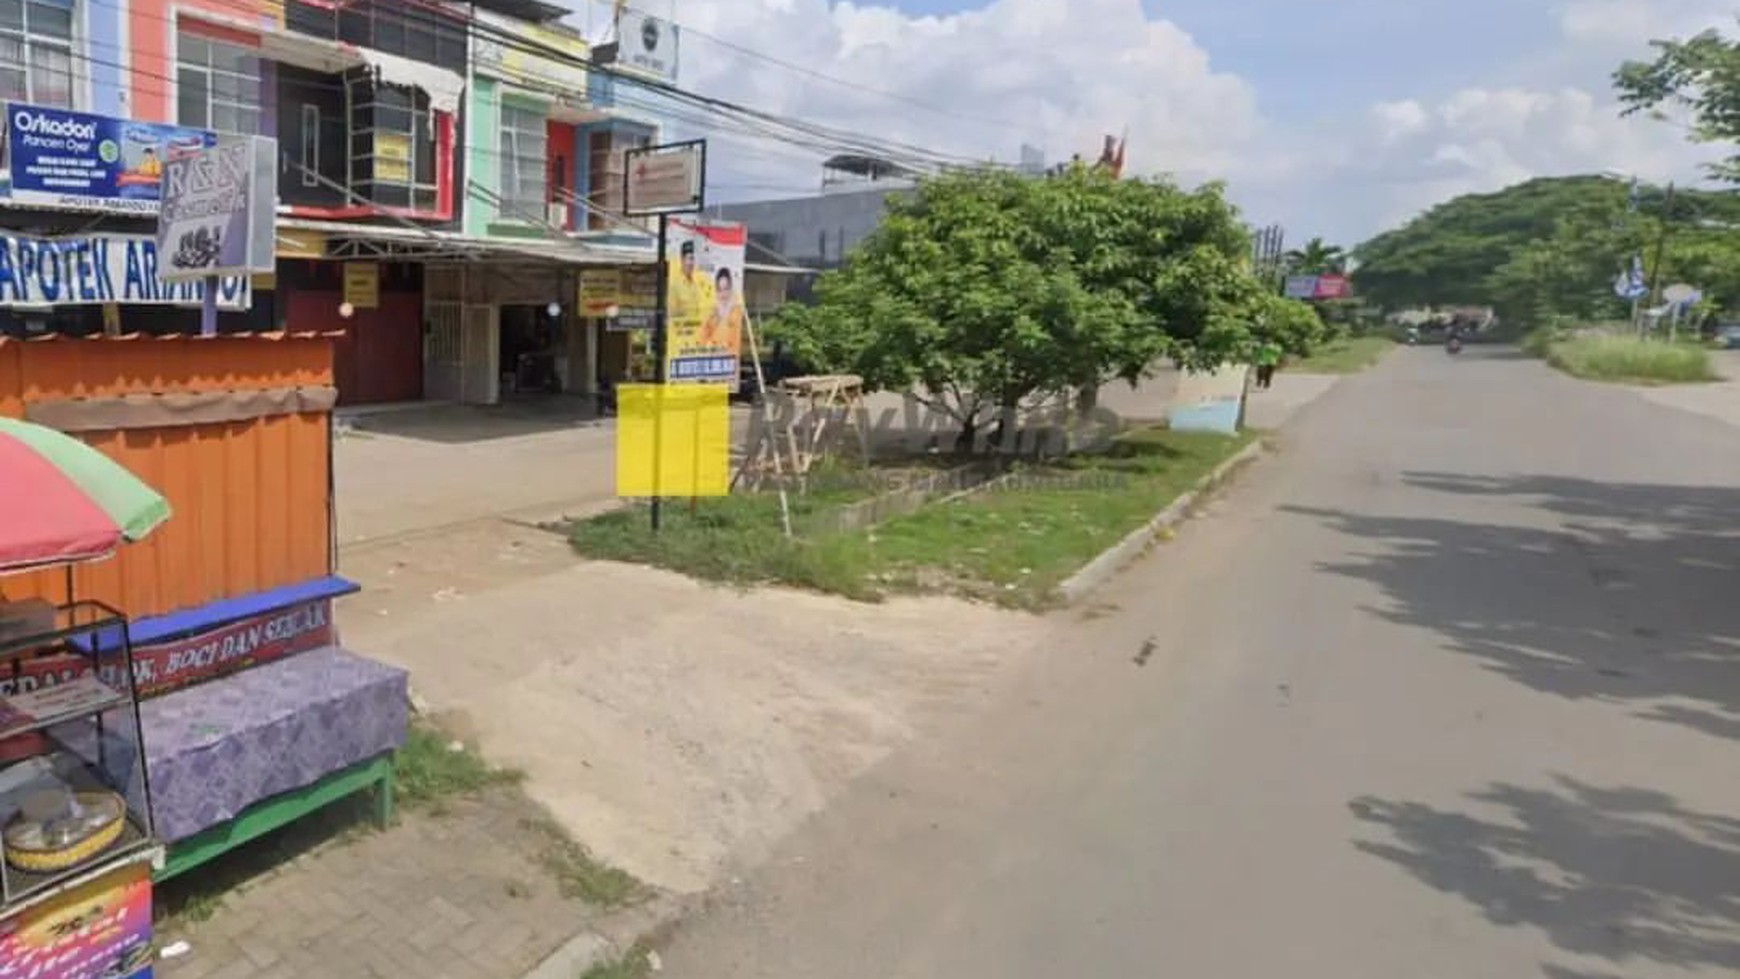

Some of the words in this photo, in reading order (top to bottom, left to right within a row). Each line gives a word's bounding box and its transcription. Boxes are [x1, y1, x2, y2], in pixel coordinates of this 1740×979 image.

[14, 111, 96, 139] Oskadon
[22, 134, 65, 150] Pancen
[218, 624, 263, 661] DAN
